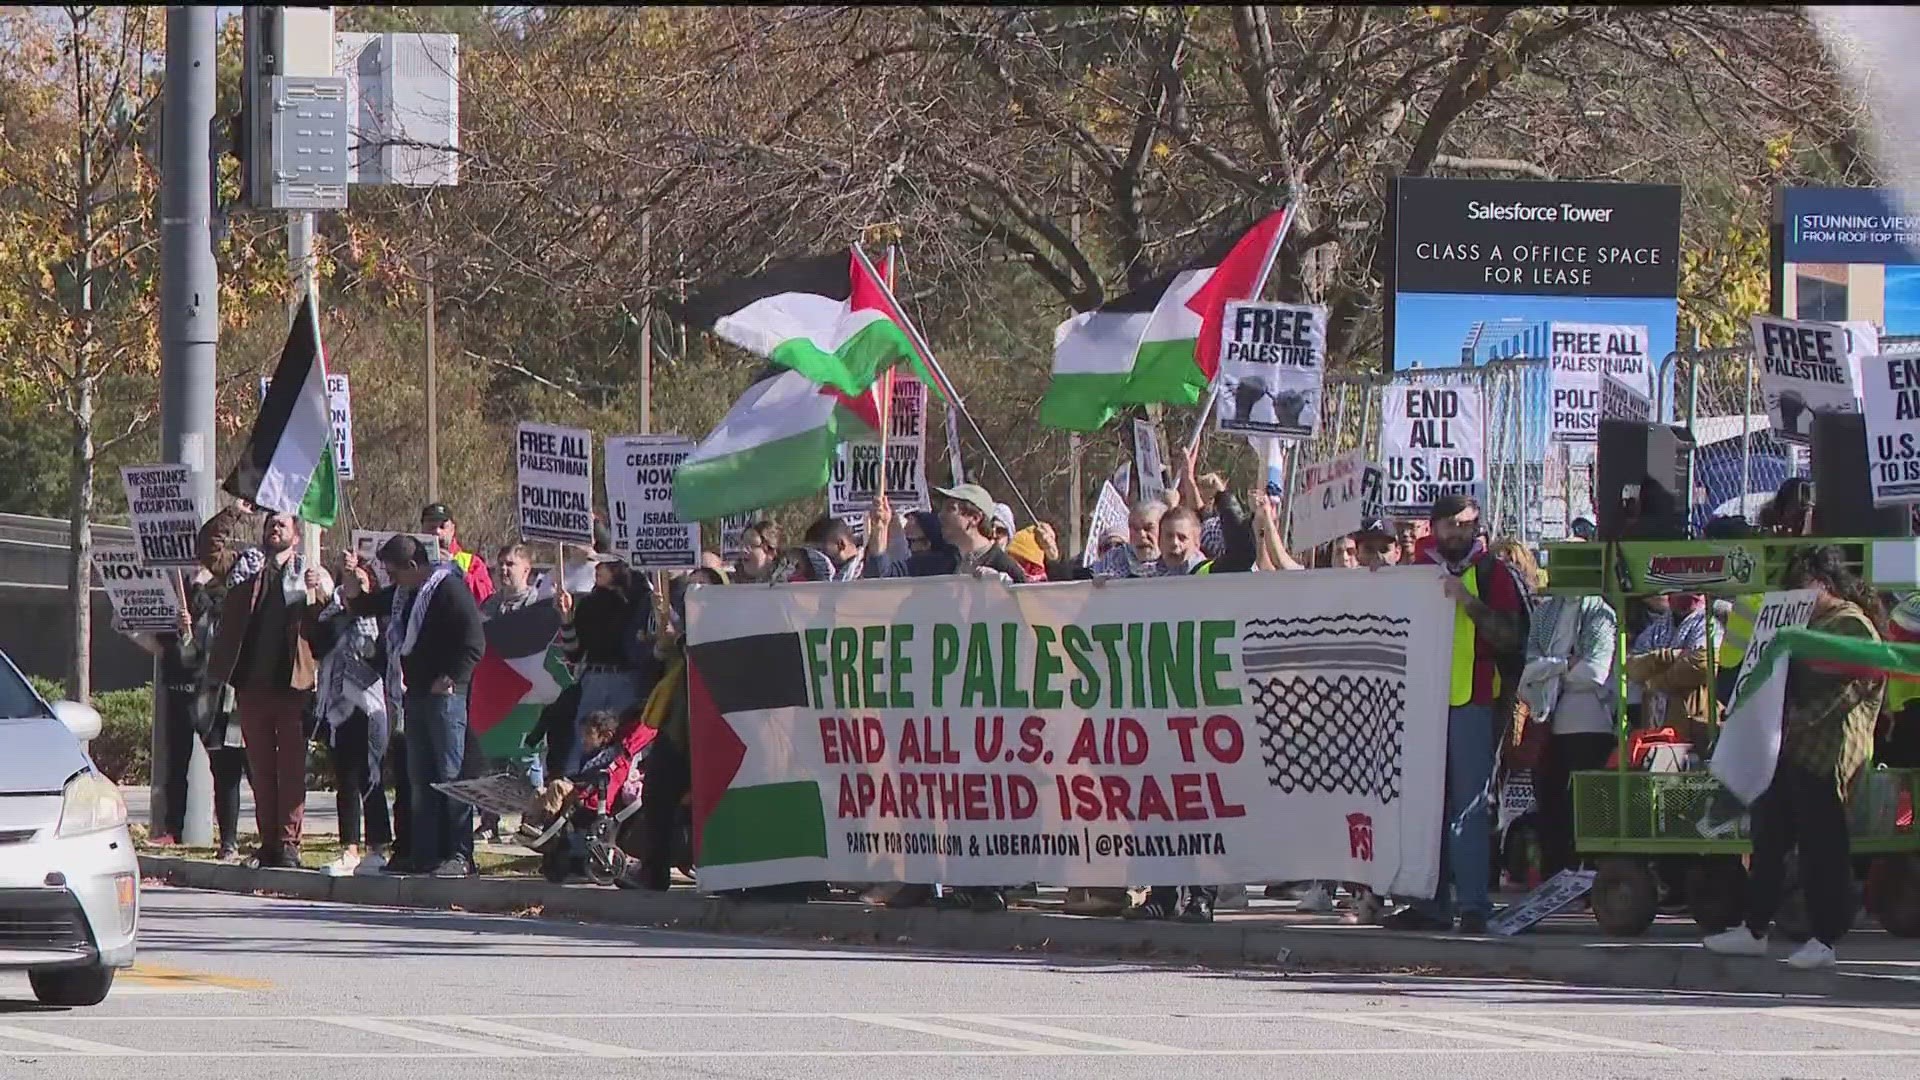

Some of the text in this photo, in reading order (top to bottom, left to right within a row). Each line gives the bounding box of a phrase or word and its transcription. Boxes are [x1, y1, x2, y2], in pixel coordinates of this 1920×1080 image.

[1467, 201, 1613, 222] Salesforce Tower
[1803, 215, 1878, 229] STUNNING
[1803, 231, 1836, 242] FROM
[1416, 243, 1660, 264] CLASS A OFFICE SPACE
[1485, 267, 1592, 285] FOR LEASE
[1235, 307, 1312, 347] FREE
[1227, 342, 1316, 367] PALESTINE
[1552, 331, 1642, 355] FREE ALL
[1763, 323, 1833, 364] FREE
[1765, 357, 1845, 384] PALESTINE
[1888, 358, 1920, 390] EN
[1406, 389, 1458, 418] END
[520, 431, 588, 460] FREE ALL
[1409, 419, 1455, 449] ALL
[520, 454, 588, 477] PALESTINIAN
[1389, 457, 1475, 482] U.S. AID
[1880, 463, 1899, 482] TO
[127, 470, 187, 486] RESISTANCE
[140, 485, 181, 499] AGAINST
[522, 485, 588, 512] POLITICAL
[1387, 483, 1406, 502] TO
[134, 498, 194, 514] OCCUPATION
[522, 507, 588, 530] PRISONERS
[643, 512, 680, 525] ISRAEL
[636, 538, 690, 550] GENOCIDE
[93, 552, 138, 561] CEASEF
[121, 606, 176, 617] GENOCIDE
[805, 620, 1243, 709] FREE PALESTINE
[819, 714, 1244, 766] END ALL U.S. AID TO
[838, 772, 1246, 821] APARTHEID ISRAEL
[847, 832, 1226, 857] PARTY FOR SOCIALISM & LIBERATION @PSLATLANTA
